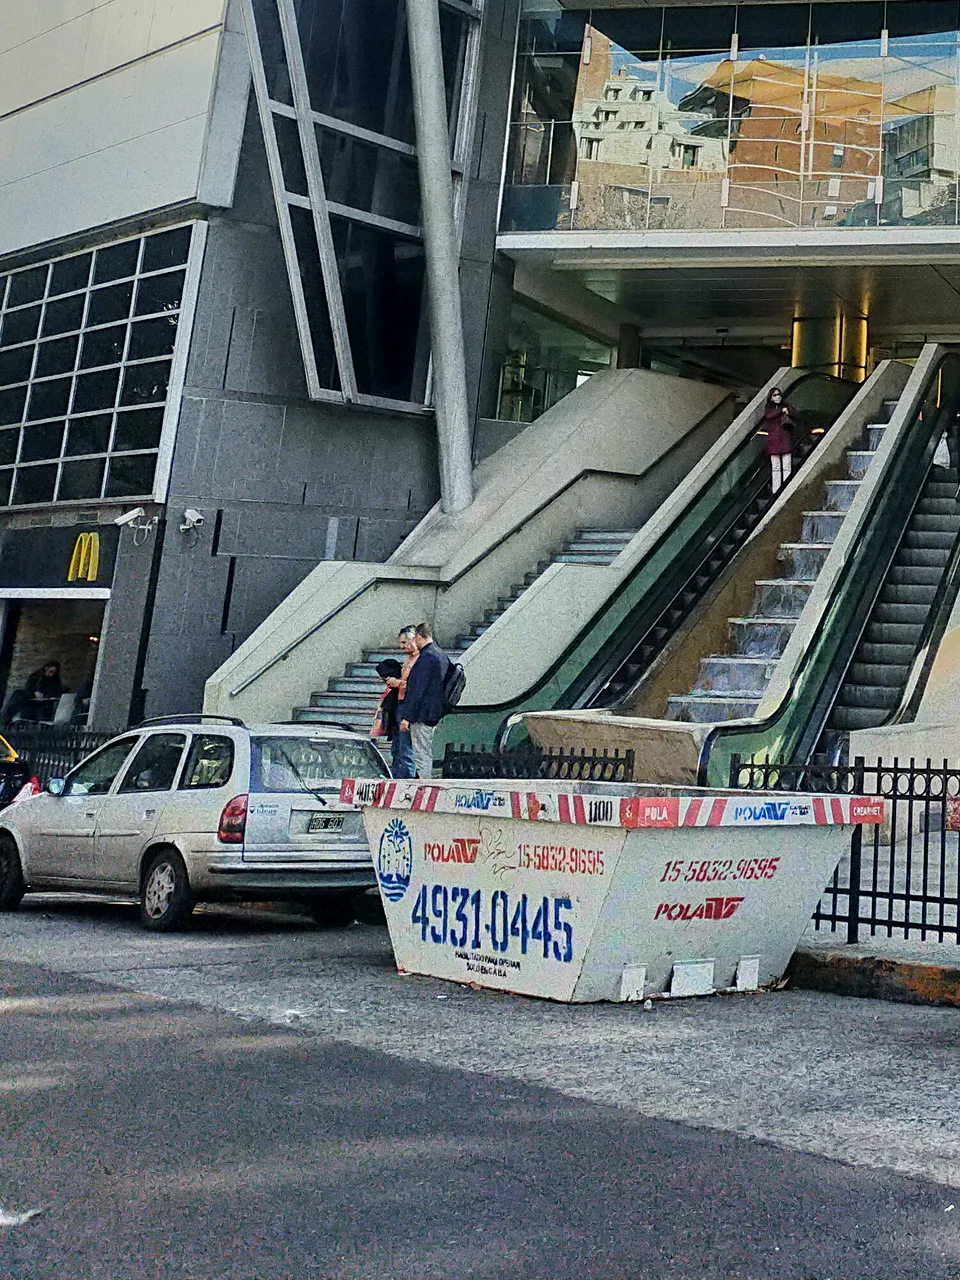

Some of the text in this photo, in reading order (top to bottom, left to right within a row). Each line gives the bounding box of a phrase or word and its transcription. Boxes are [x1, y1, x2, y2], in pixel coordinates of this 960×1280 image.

[589, 800, 612, 823] 1100
[518, 844, 605, 875] 15-5832-9695
[660, 857, 781, 882] 15-5832-9695
[411, 883, 573, 963] 4931-0445
